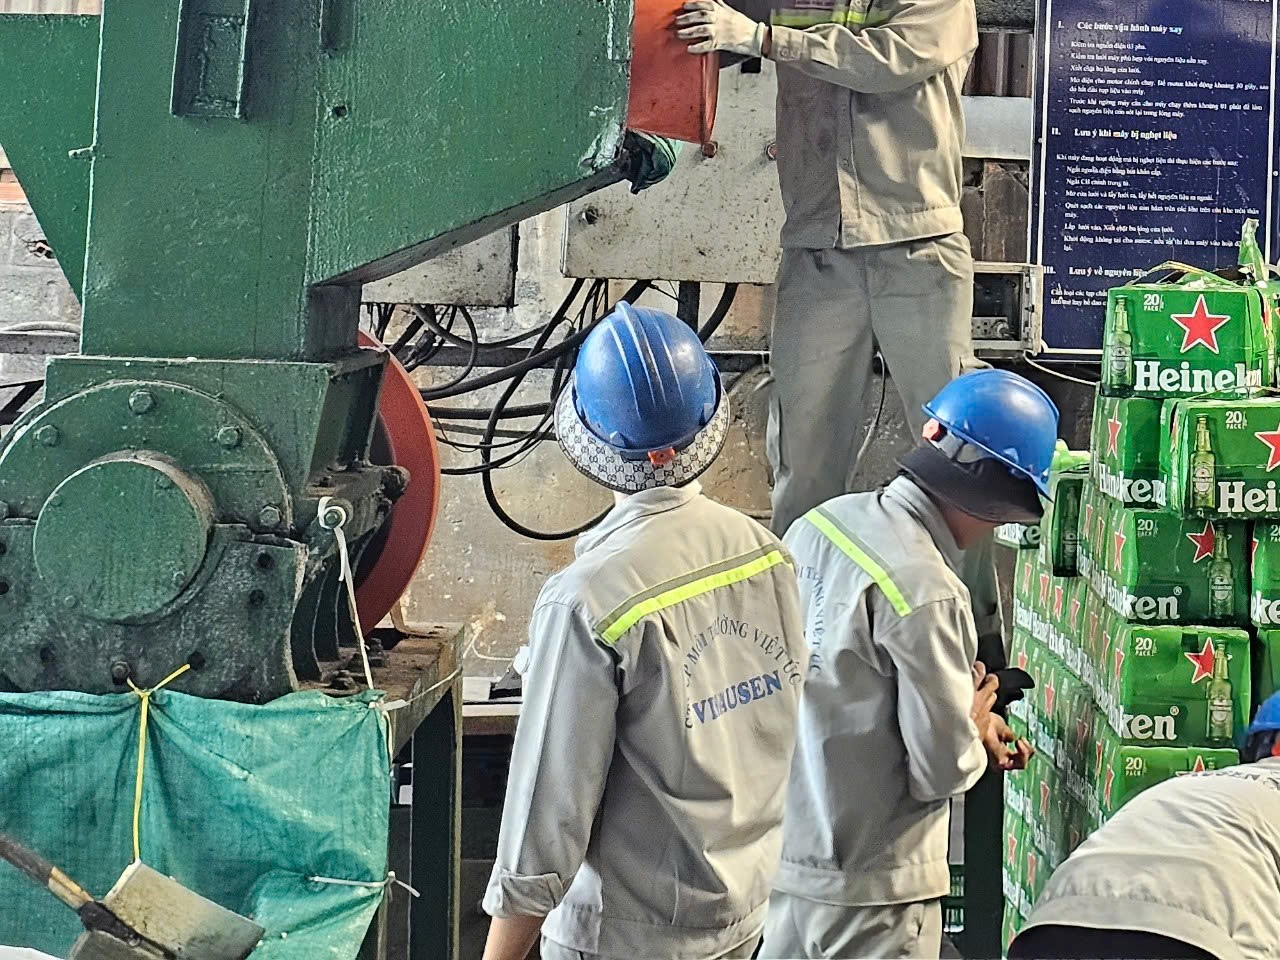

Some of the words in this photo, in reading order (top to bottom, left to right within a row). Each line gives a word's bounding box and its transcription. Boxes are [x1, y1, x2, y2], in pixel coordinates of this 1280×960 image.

[1151, 23, 1167, 34] máy
[1169, 26, 1183, 35] xay
[1074, 127, 1091, 137] Lưu
[1099, 128, 1112, 138] khi
[1069, 267, 1085, 275] Lưu
[1144, 294, 1160, 305] 20
[1226, 411, 1242, 423] 20
[1137, 519, 1154, 530] 20
[1135, 638, 1153, 650] 20
[1125, 757, 1143, 769] 20
